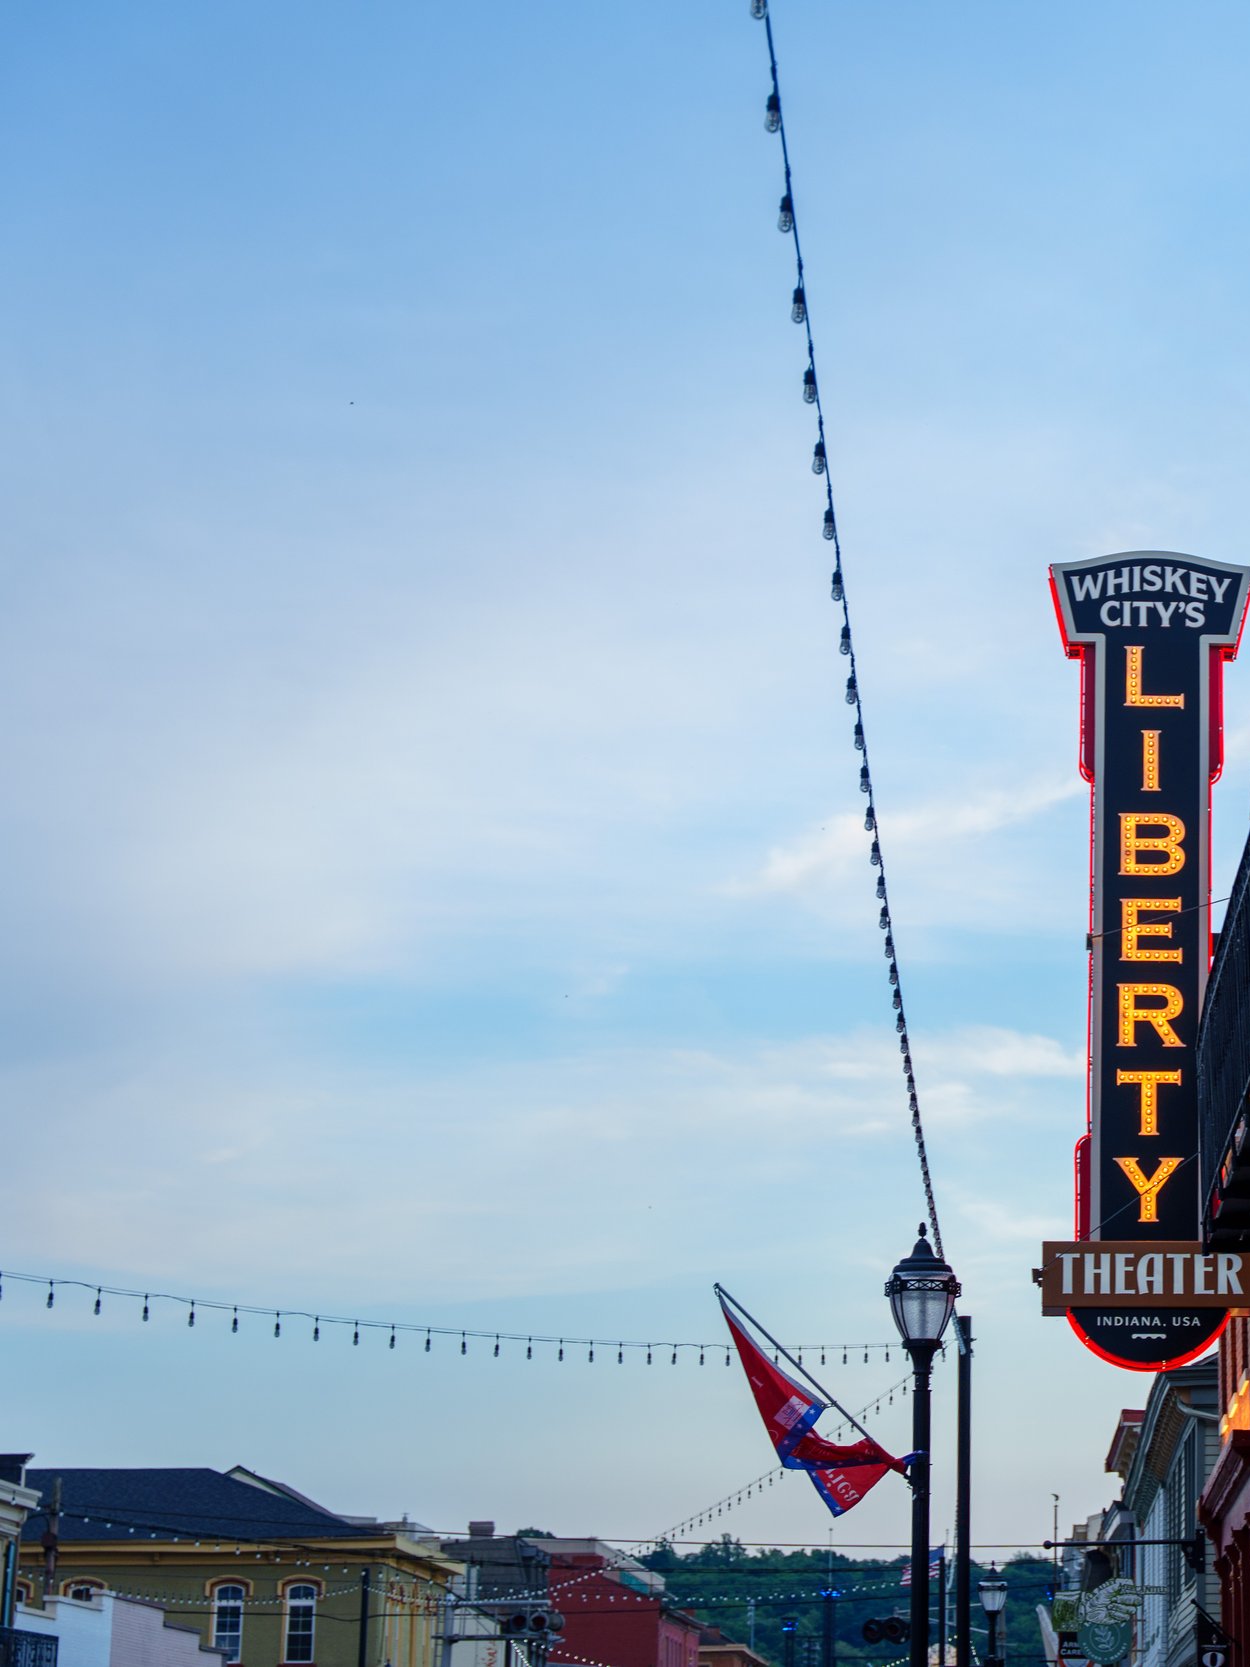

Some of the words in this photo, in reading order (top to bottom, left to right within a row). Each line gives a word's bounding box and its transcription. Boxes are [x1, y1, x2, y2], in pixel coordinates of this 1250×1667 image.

[1070, 565, 1232, 603] WHISKEY
[1100, 601, 1206, 628] CITY'S
[1112, 645, 1187, 1222] LIBERTY
[1056, 1252, 1244, 1295] THEATER
[1172, 1316, 1201, 1327] USA
